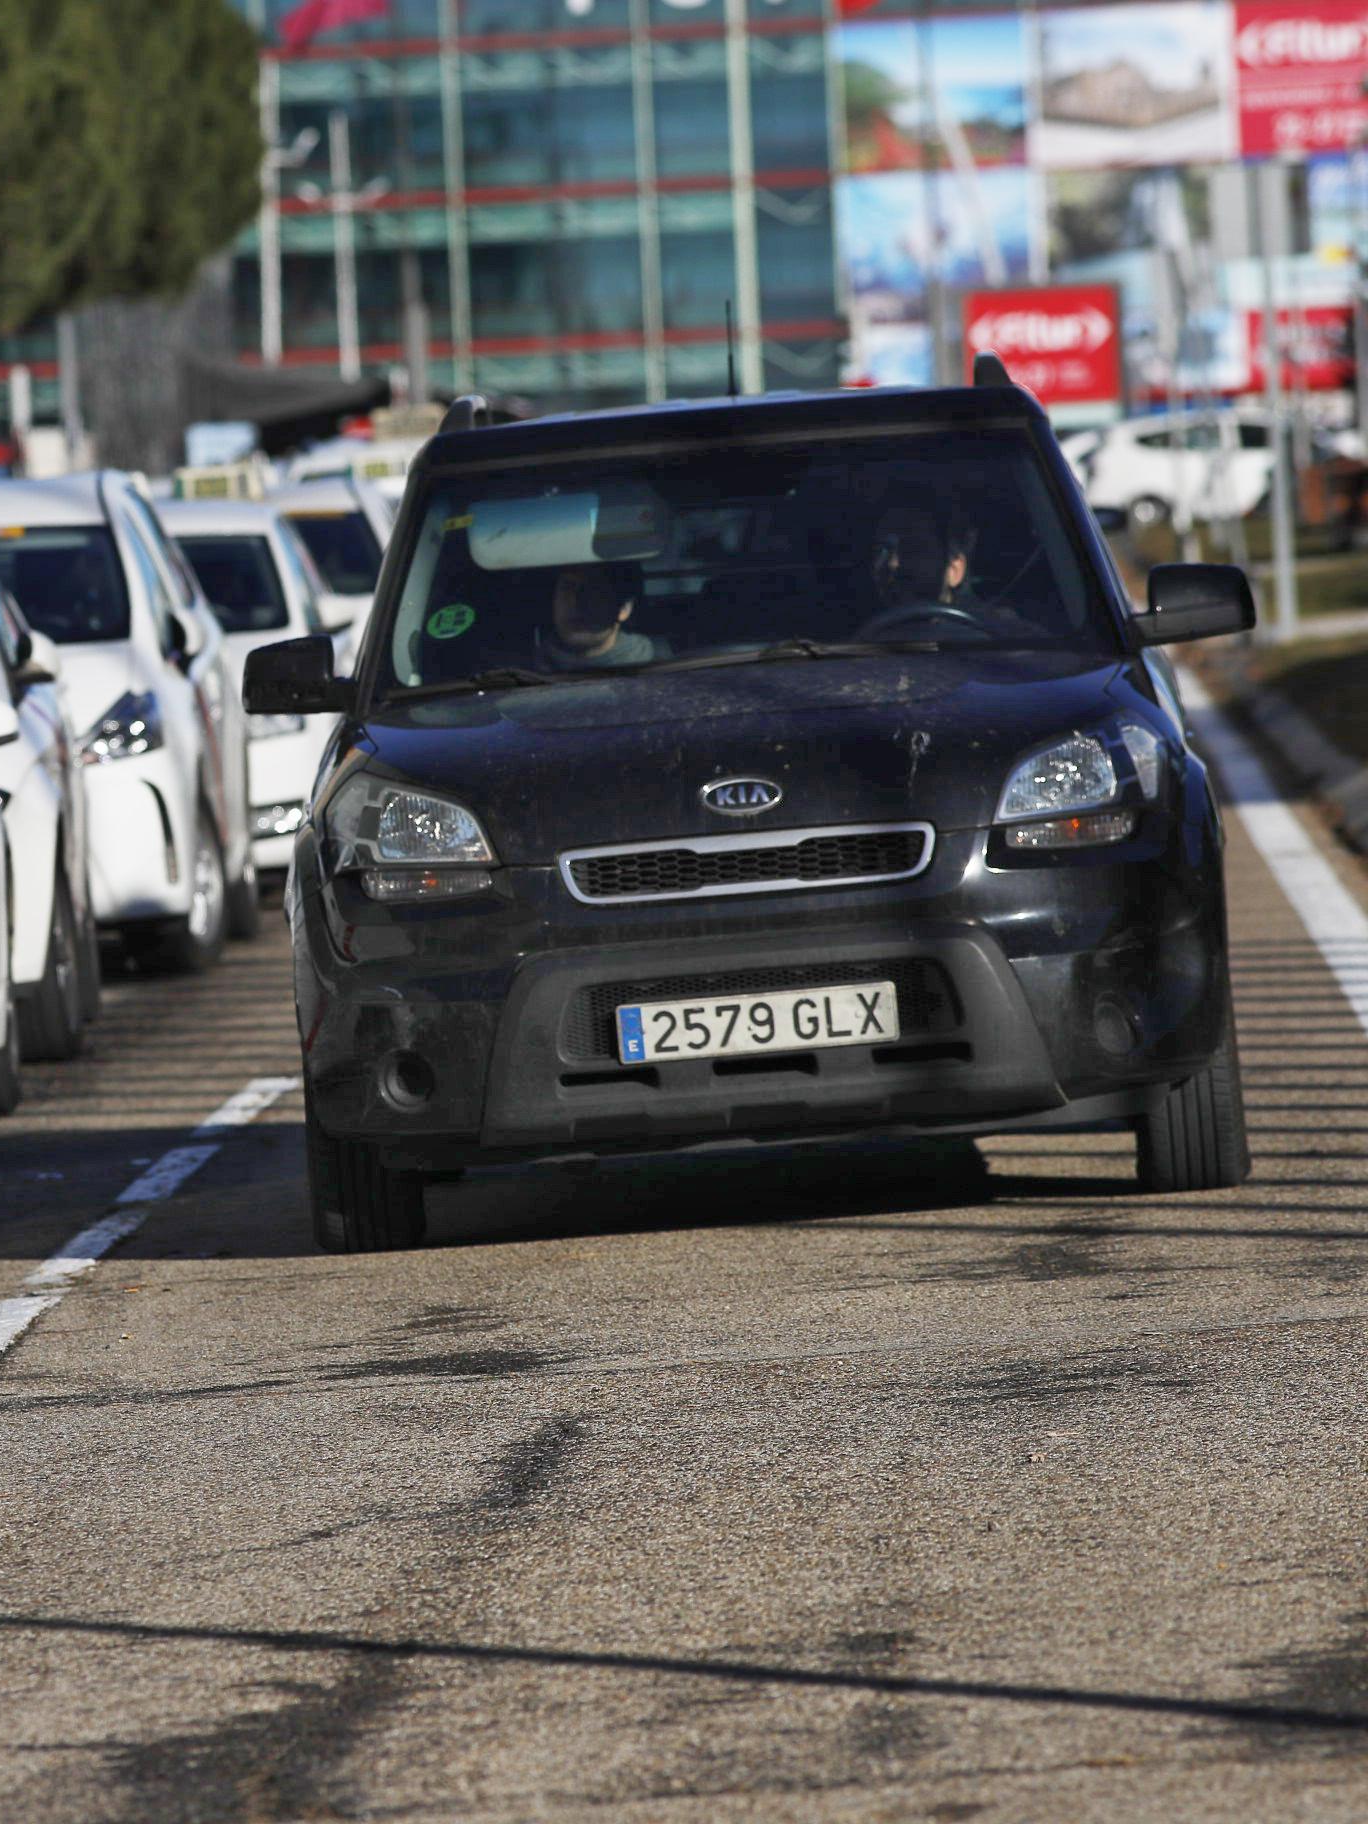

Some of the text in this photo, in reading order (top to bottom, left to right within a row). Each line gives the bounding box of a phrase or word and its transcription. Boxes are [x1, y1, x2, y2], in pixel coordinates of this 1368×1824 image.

[716, 784, 770, 805] KIA
[628, 992, 885, 1053] E 2579 GLX
